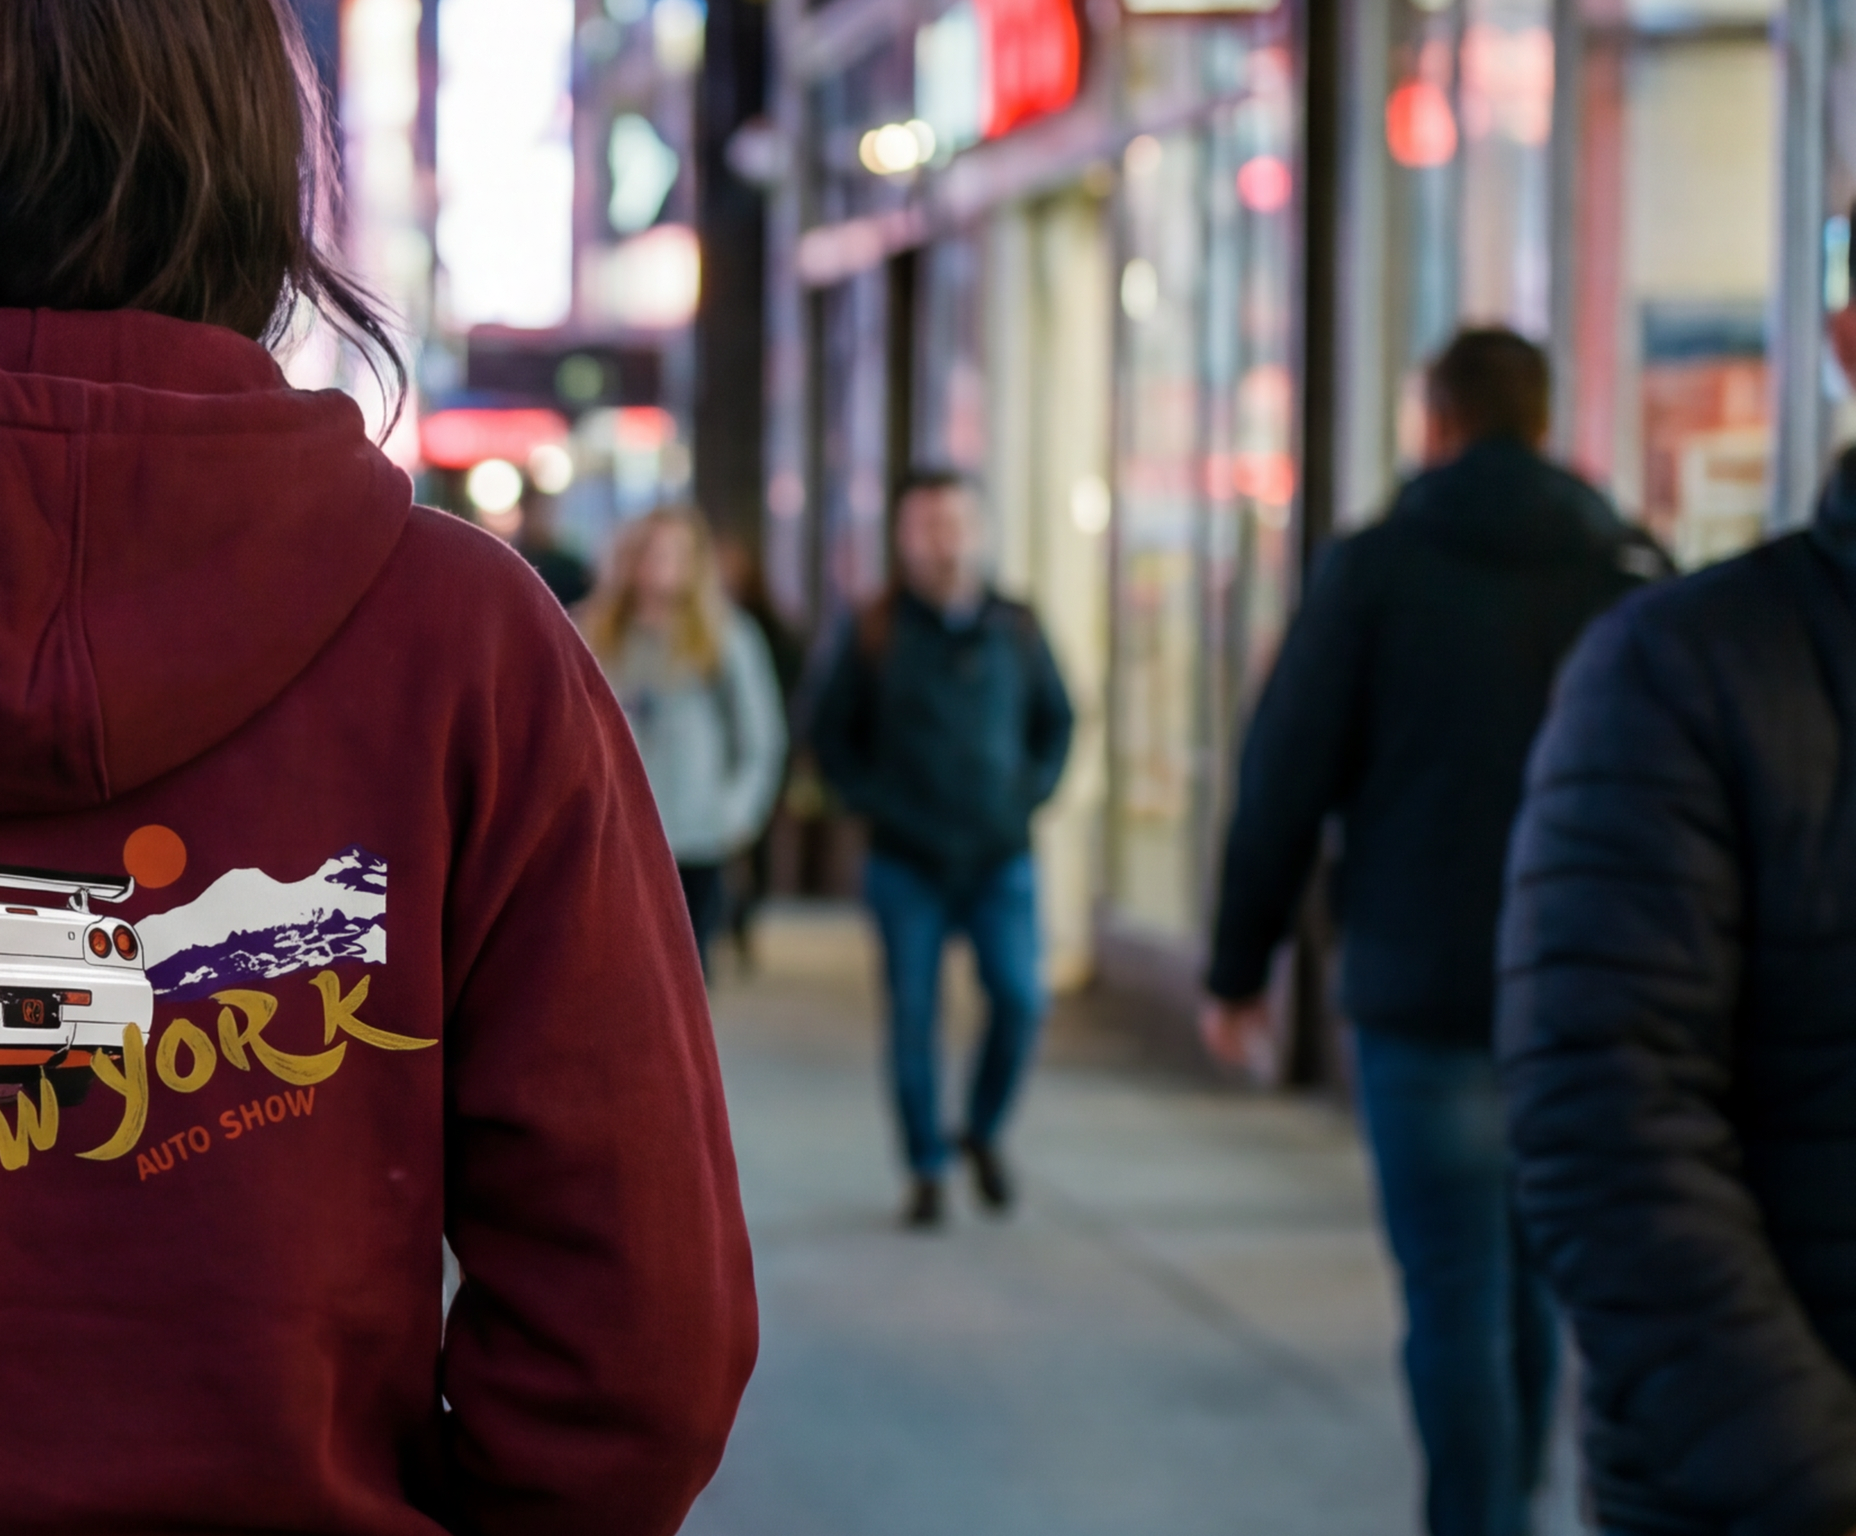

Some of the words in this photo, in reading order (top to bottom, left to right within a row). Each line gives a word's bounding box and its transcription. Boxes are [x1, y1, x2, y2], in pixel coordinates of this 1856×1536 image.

[75, 969, 439, 1161] YORK
[135, 1124, 211, 1182] AUTO
[218, 1085, 317, 1141] SHOW
